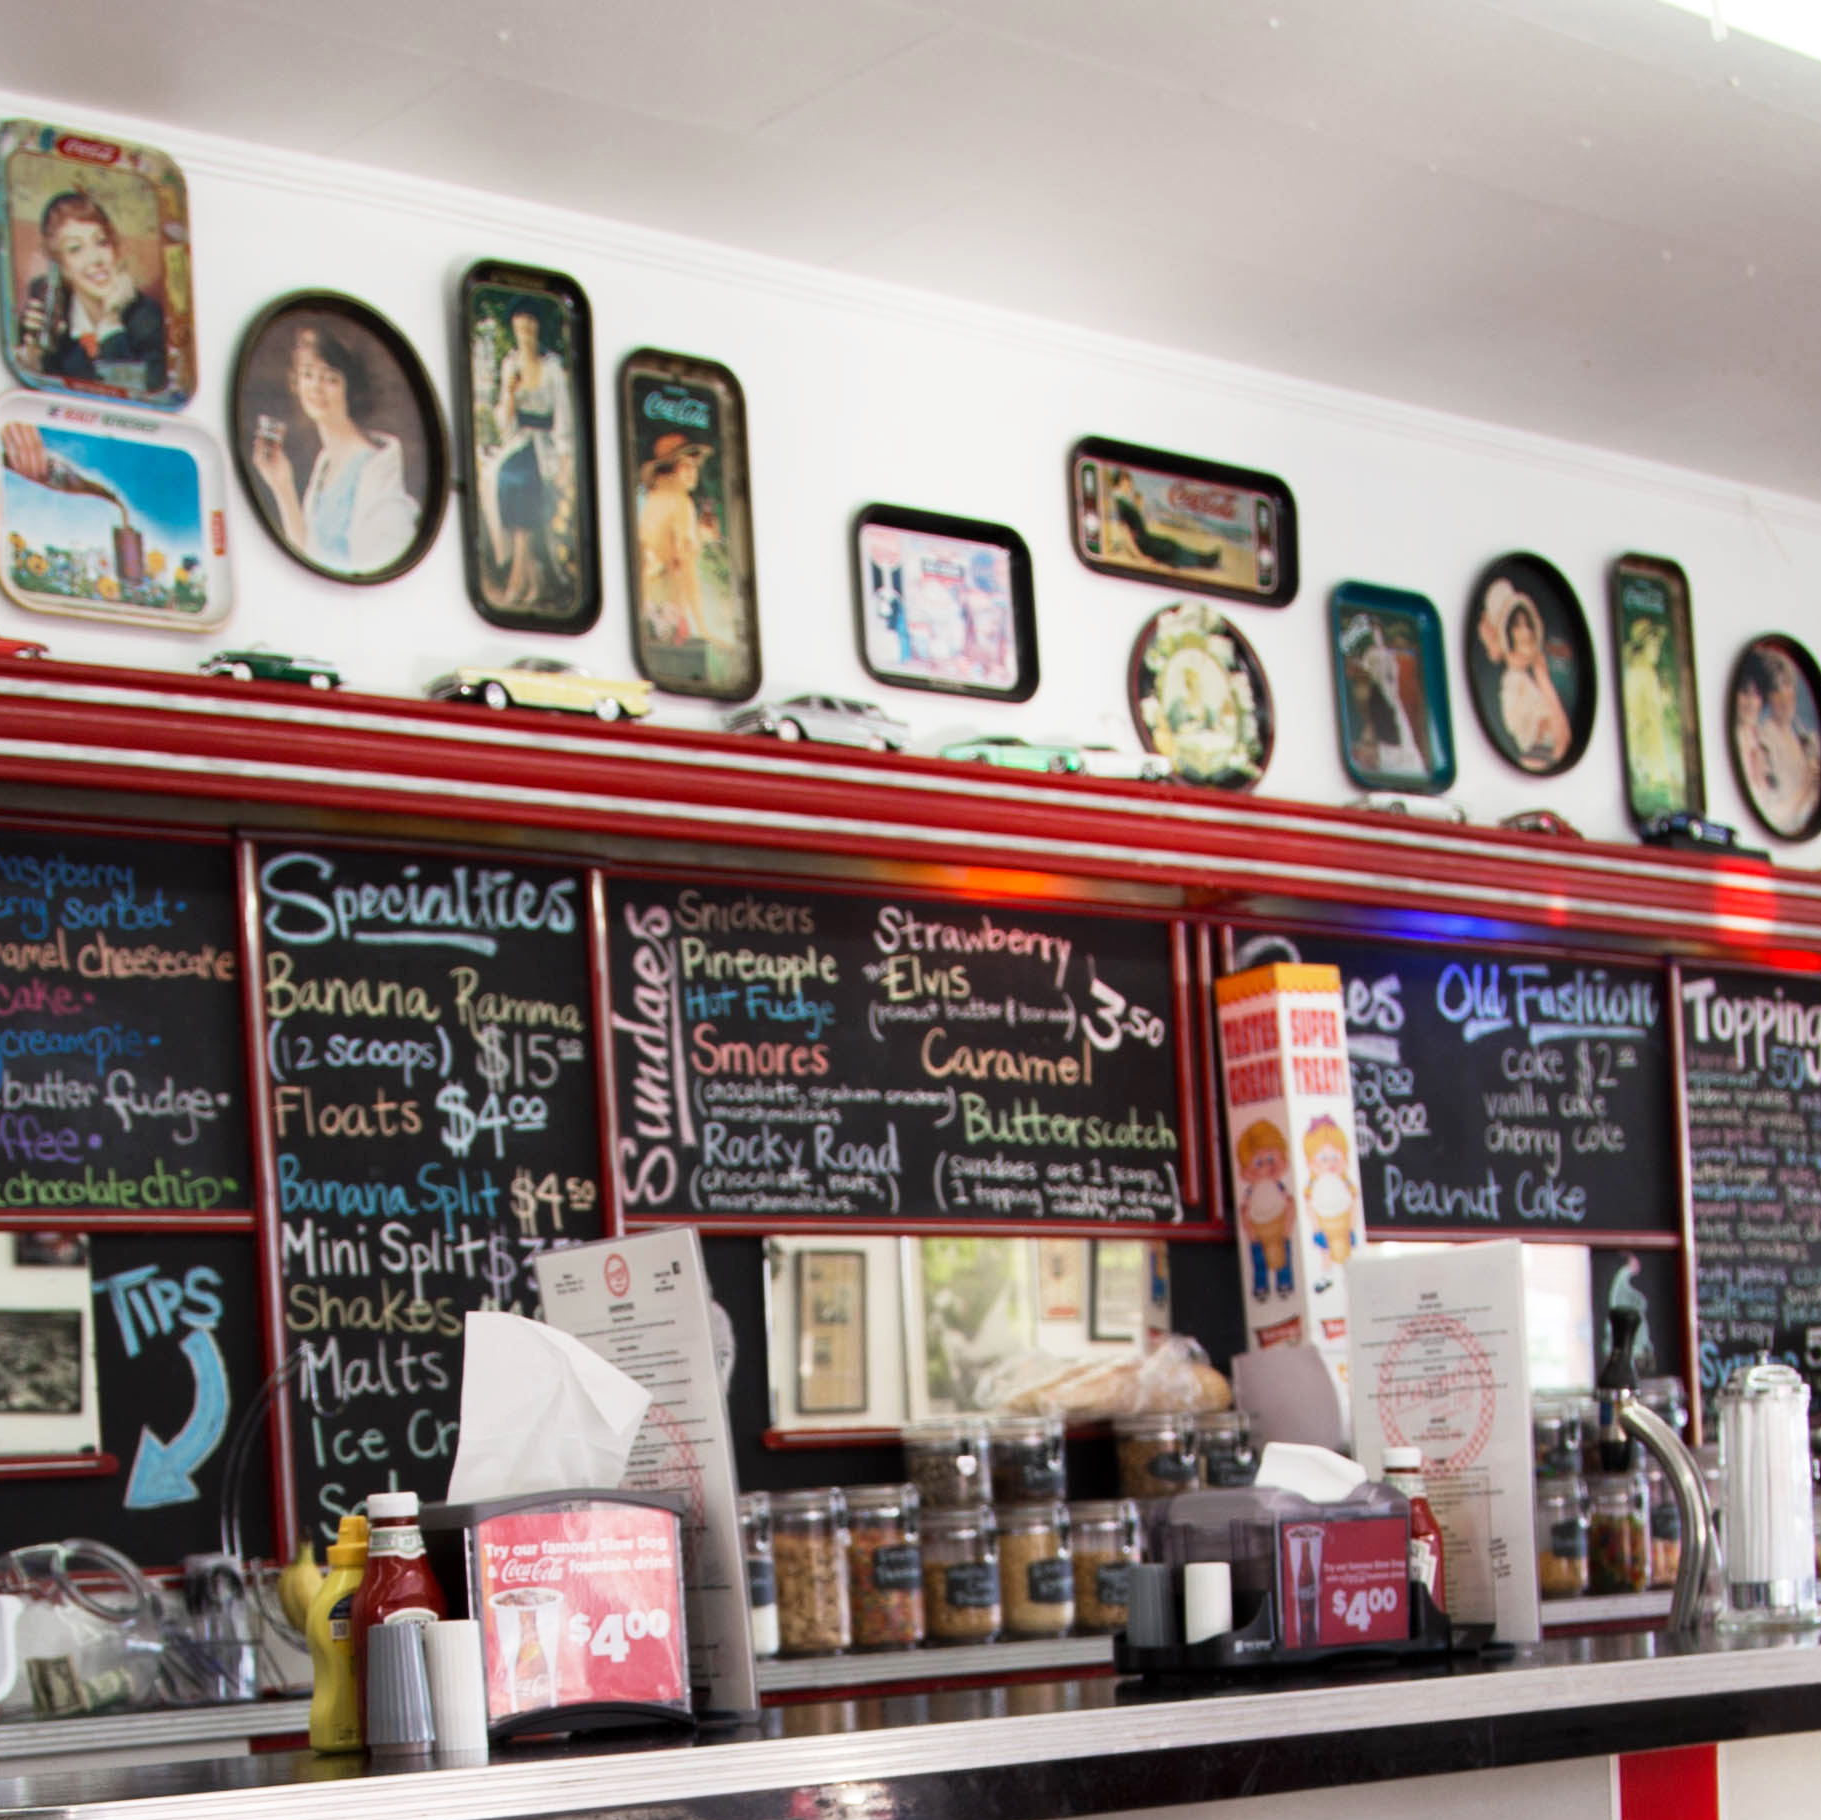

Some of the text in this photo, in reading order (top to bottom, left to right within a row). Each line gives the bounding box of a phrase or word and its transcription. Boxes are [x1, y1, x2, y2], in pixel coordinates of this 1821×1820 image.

[60, 887, 173, 932] sorbet
[260, 850, 577, 945] Specialties
[675, 888, 816, 935] Snickers
[681, 936, 840, 997] Pineapple
[872, 904, 1072, 990] Strawberry
[879, 953, 972, 1002] Elvis
[266, 950, 442, 1022] Banana
[746, 983, 838, 1040] Fudge
[1436, 962, 1508, 1023] Old
[1507, 963, 1661, 1029] Fashion
[83, 1021, 149, 1077] pie
[611, 900, 678, 1206] Sundaes
[690, 1021, 831, 1077] Smores
[920, 1026, 1093, 1087] Caramel
[1, 1069, 98, 1110] butter
[104, 1068, 218, 1146] fudge
[270, 1085, 423, 1138] Floats
[959, 1090, 1179, 1151] Butterscotch
[703, 1120, 903, 1176] Rocky Road
[140, 1158, 224, 1211] chip
[278, 1151, 418, 1218] Banana
[416, 1160, 502, 1242] Split
[1382, 1163, 1504, 1222] Peanut
[280, 1217, 488, 1305] Mini Split
[92, 1264, 224, 1359] TIPS
[285, 1277, 464, 1338] Shakes
[298, 1335, 450, 1403] Malts
[310, 1408, 460, 1468] Ice Cr
